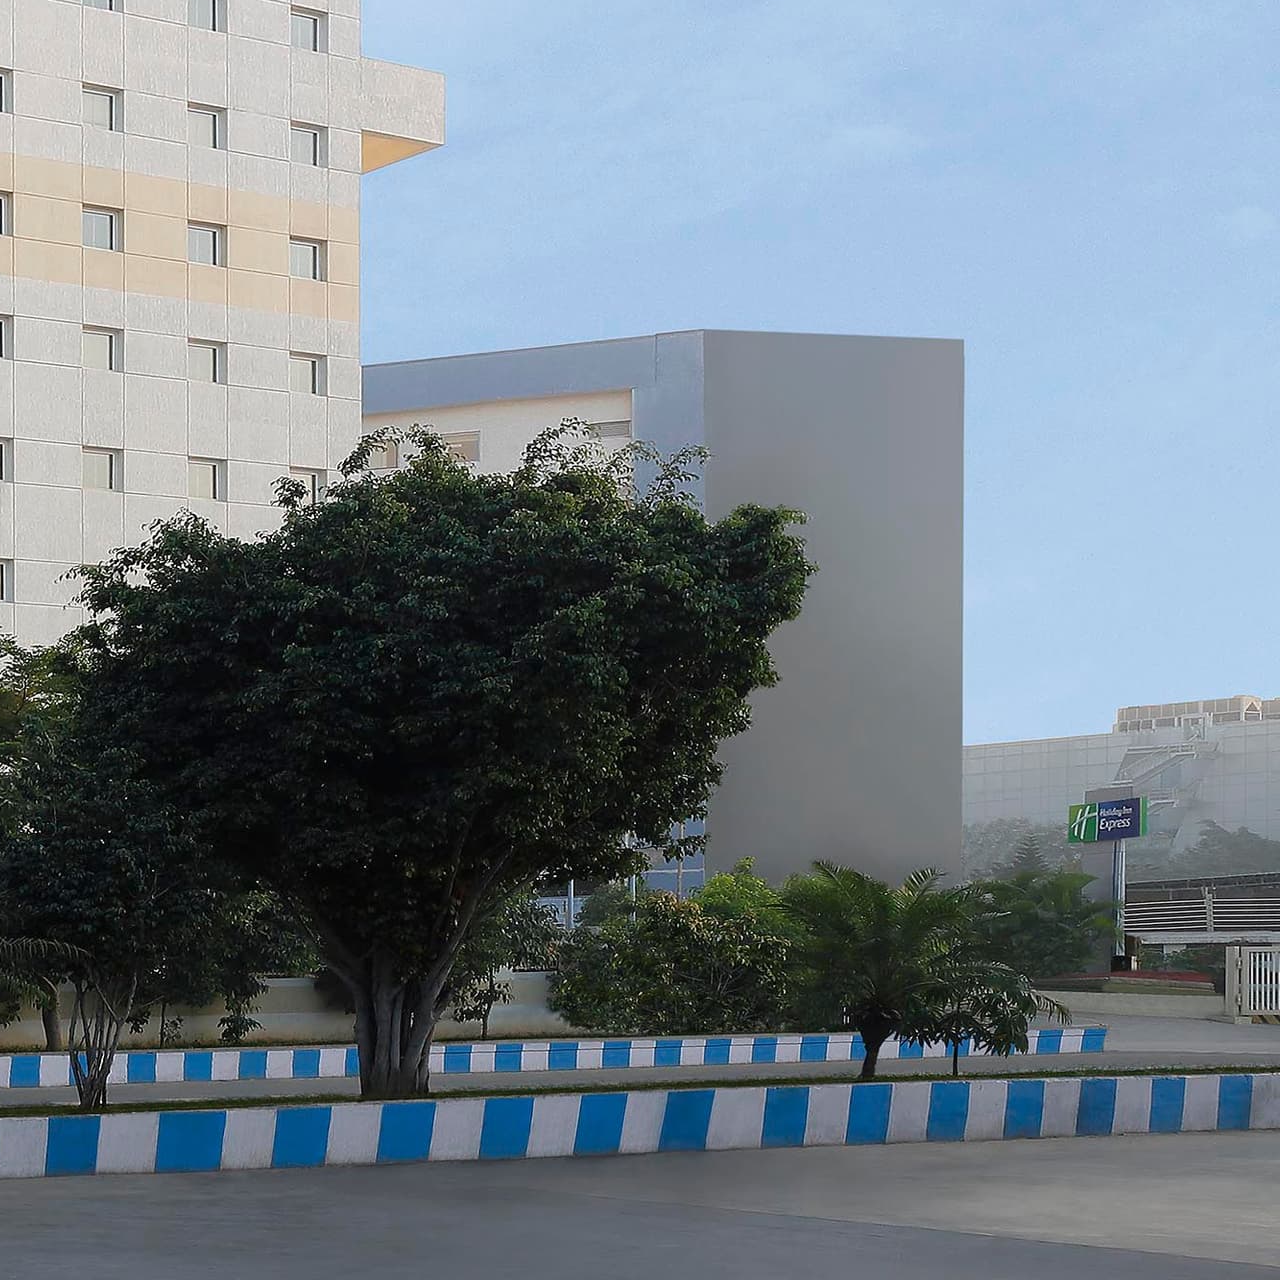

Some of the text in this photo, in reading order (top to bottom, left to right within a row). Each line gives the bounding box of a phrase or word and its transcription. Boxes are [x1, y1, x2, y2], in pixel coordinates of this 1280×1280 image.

[1100, 807, 1122, 817] Holiday
[1071, 805, 1097, 840] H
[1100, 818, 1131, 831] Express
